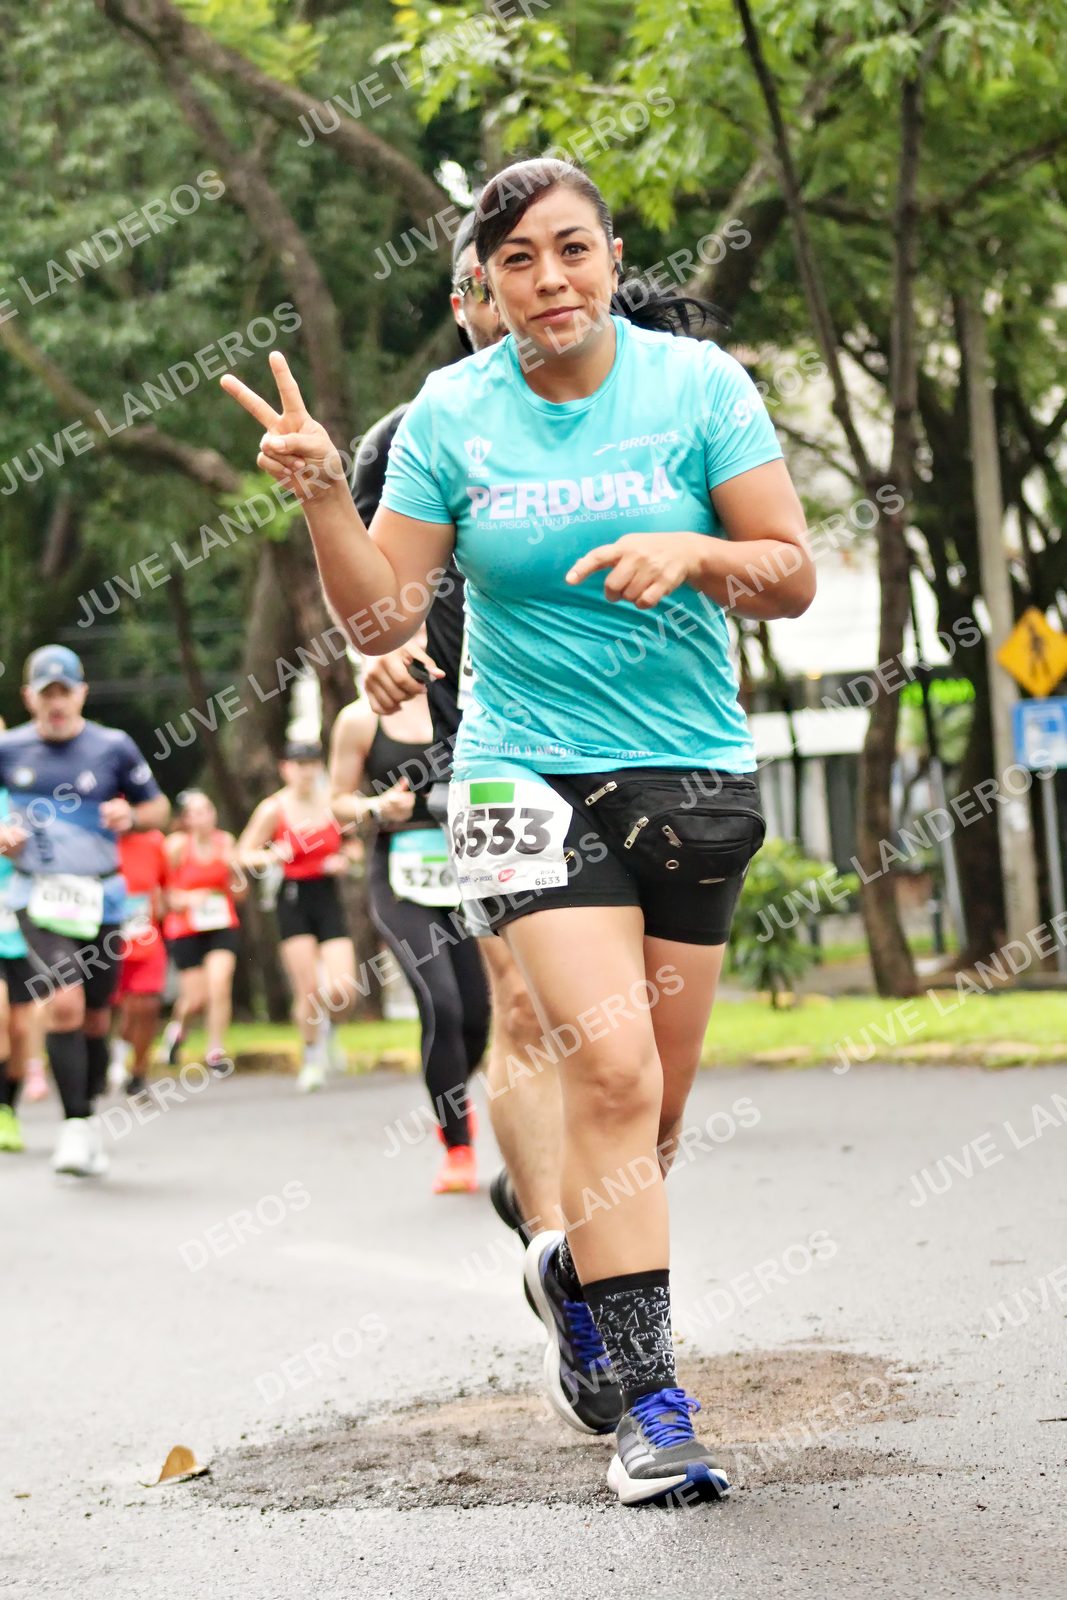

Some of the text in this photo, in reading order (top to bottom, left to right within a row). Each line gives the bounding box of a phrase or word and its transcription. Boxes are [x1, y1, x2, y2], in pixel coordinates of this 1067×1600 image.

[619, 430, 680, 450] BROOKS
[466, 466, 679, 520] PERDURA
[499, 519, 530, 530] PISOS
[540, 509, 618, 526] JUNTEADORES
[626, 503, 672, 518] ESTUCOS
[452, 807, 555, 859] 6533
[535, 876, 560, 886] 6533
